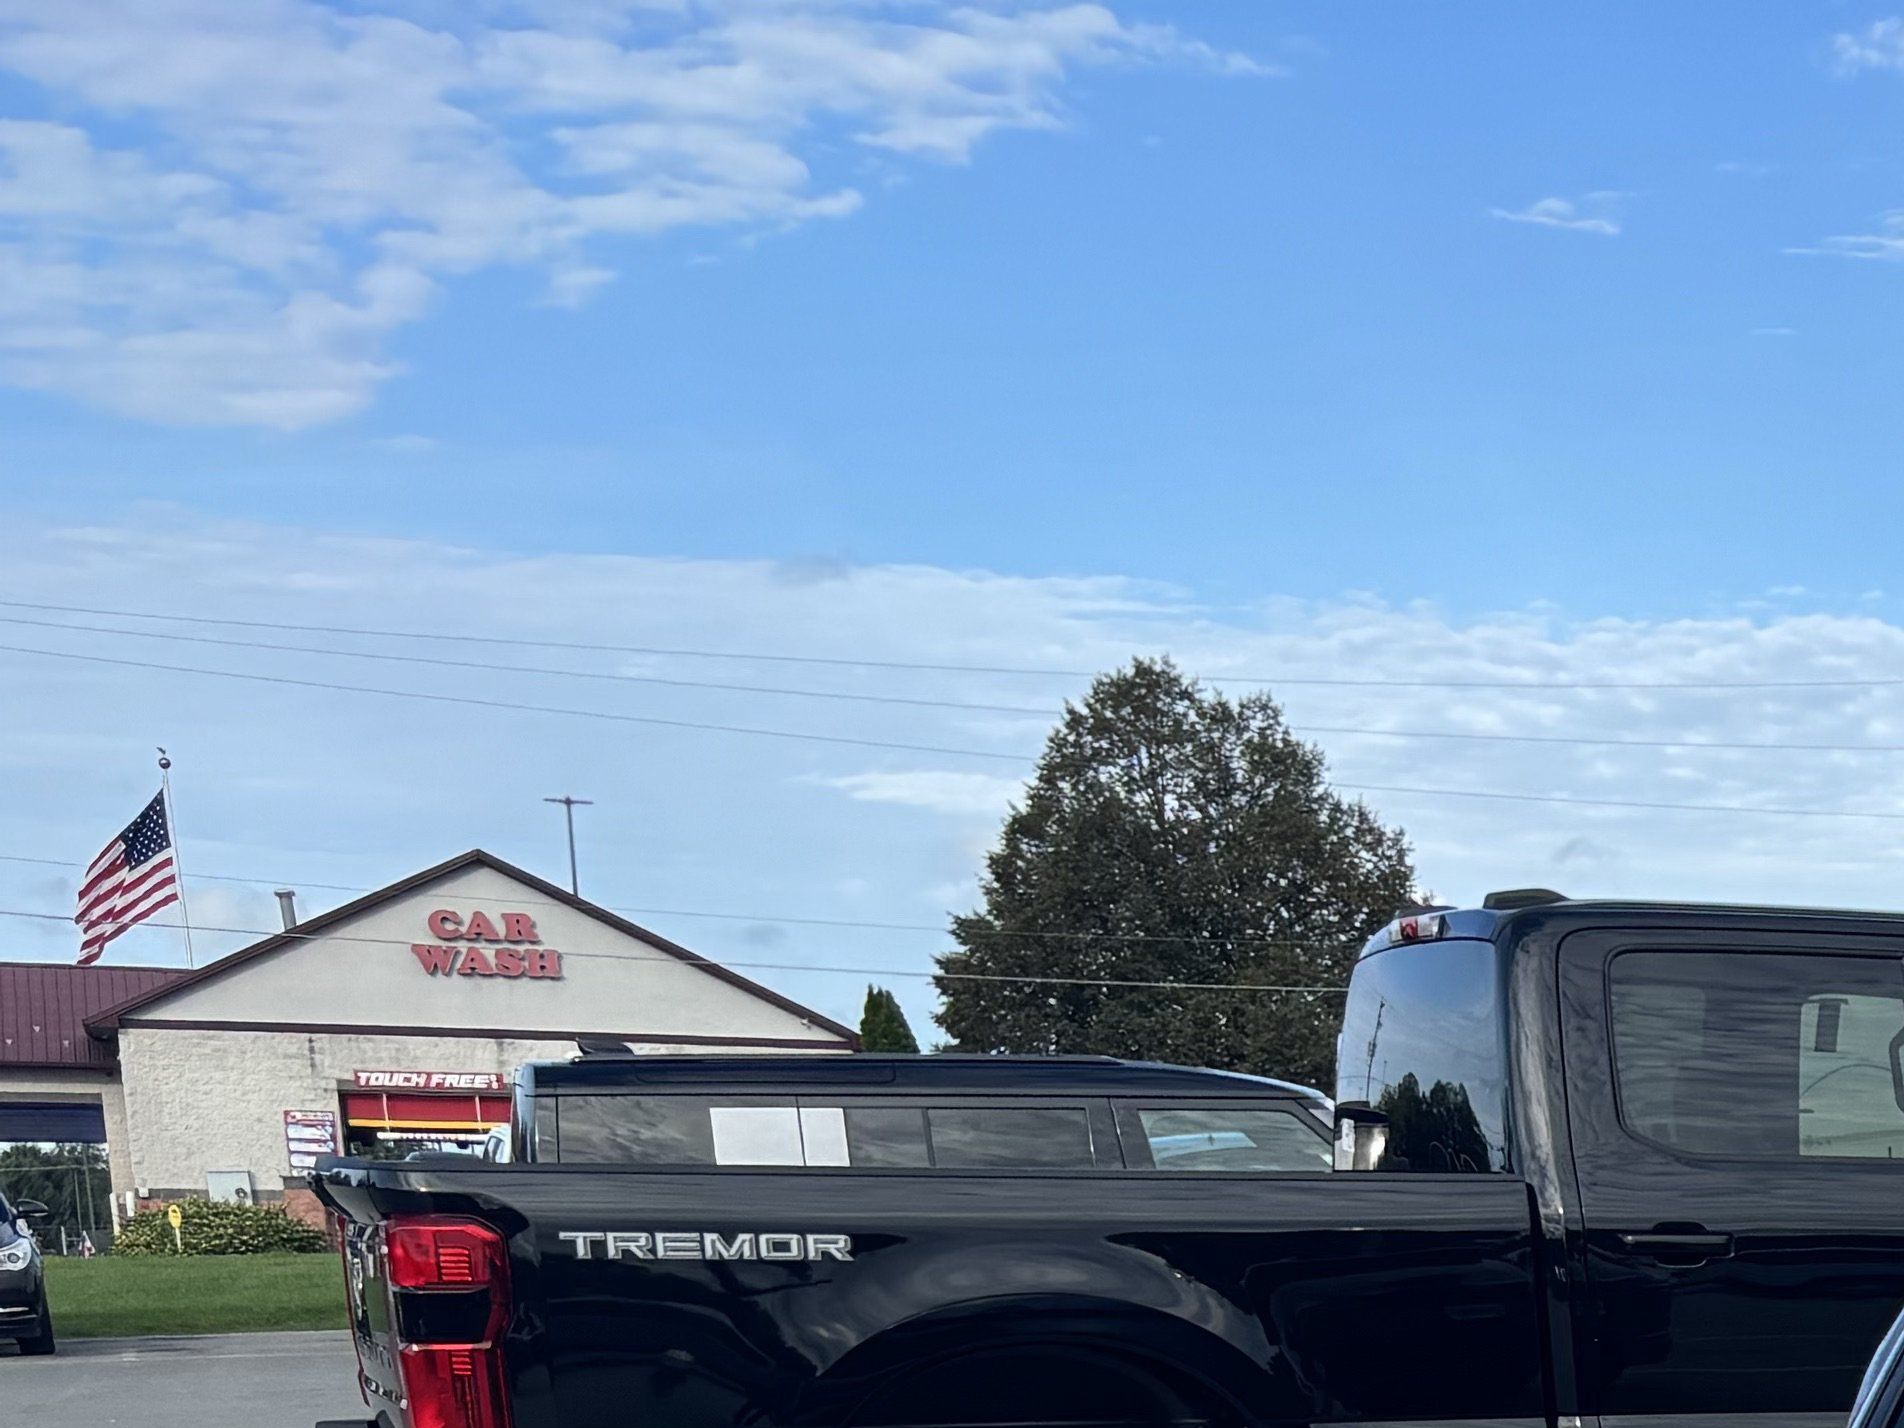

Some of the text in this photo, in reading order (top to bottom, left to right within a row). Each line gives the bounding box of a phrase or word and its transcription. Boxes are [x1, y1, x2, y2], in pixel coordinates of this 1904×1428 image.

[427, 909, 542, 943] CAR
[410, 943, 563, 980] WASH
[357, 1072, 428, 1088] TOUCH
[558, 1231, 855, 1261] TREMOR
